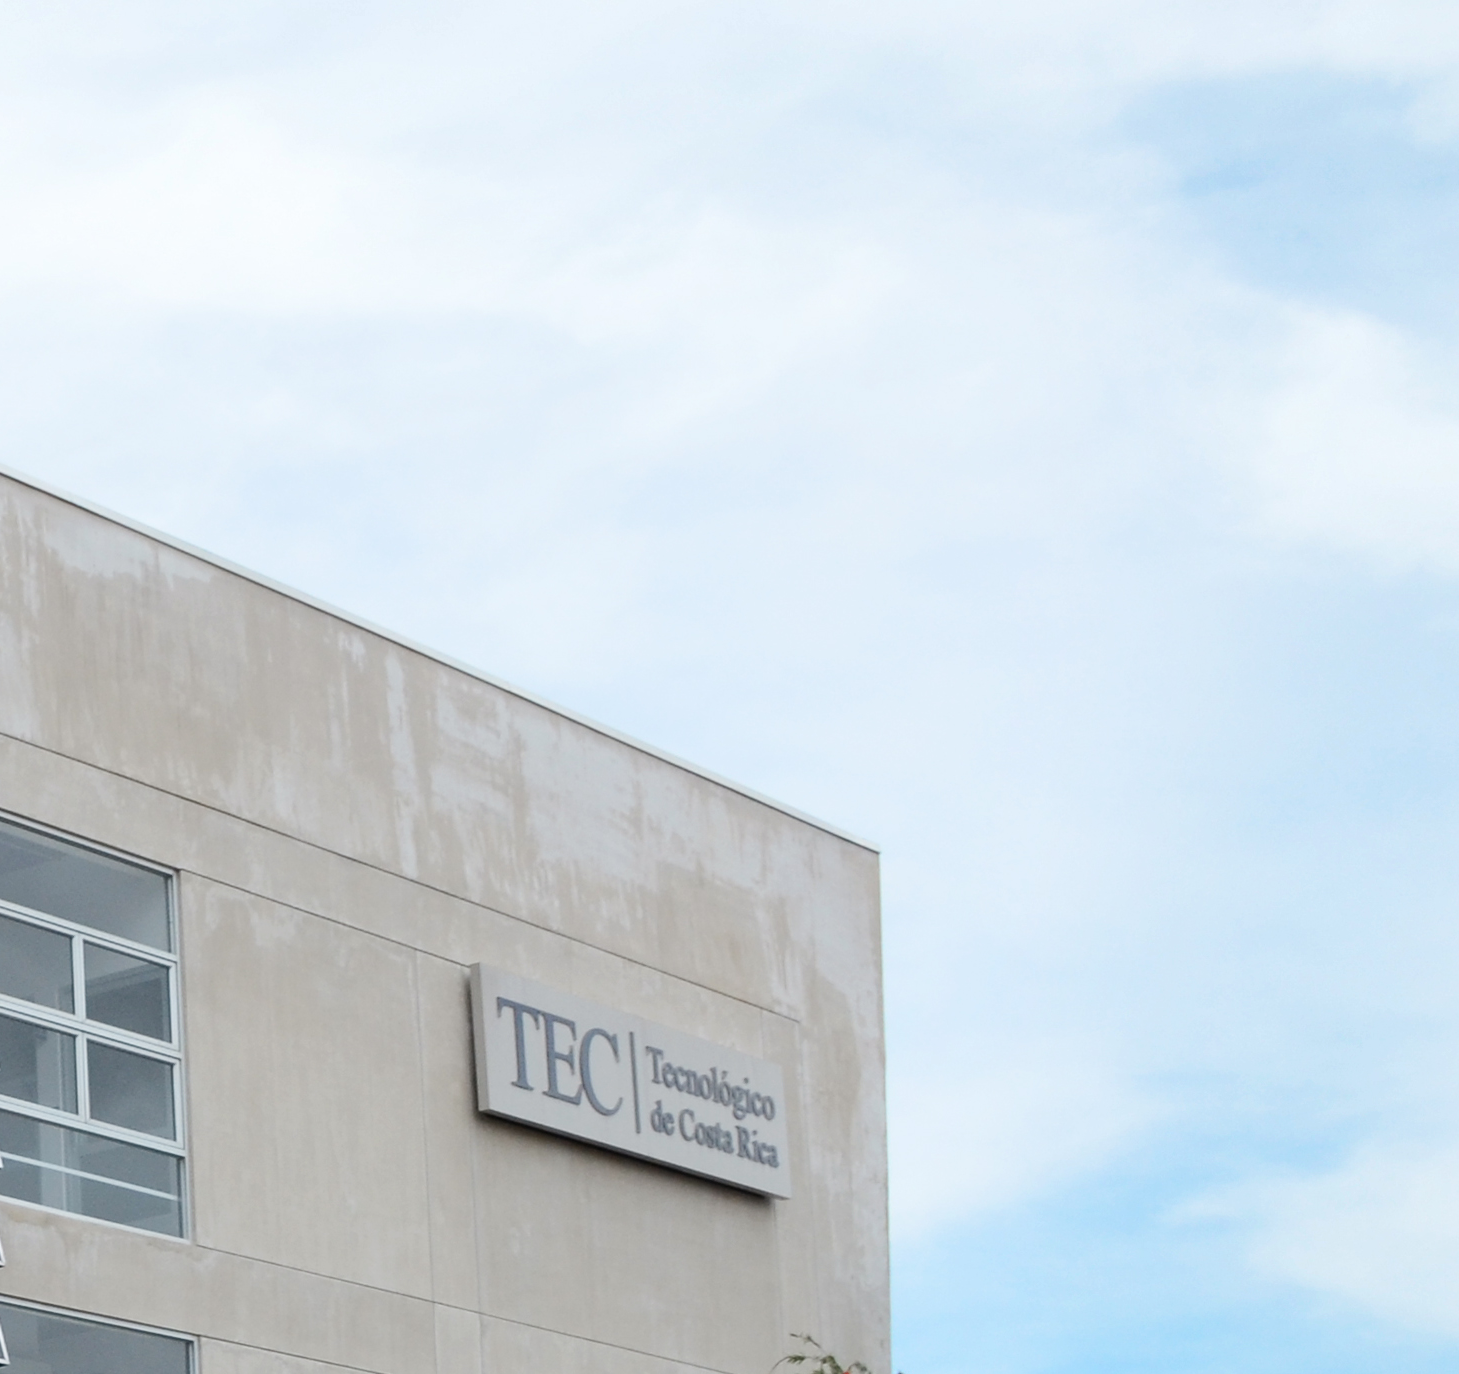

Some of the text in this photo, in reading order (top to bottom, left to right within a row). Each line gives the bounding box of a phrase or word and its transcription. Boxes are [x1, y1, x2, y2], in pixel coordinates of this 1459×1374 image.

[496, 996, 623, 1116] TEC
[645, 1045, 775, 1121] Tecnológico
[650, 1100, 780, 1168] de Costa Rica
